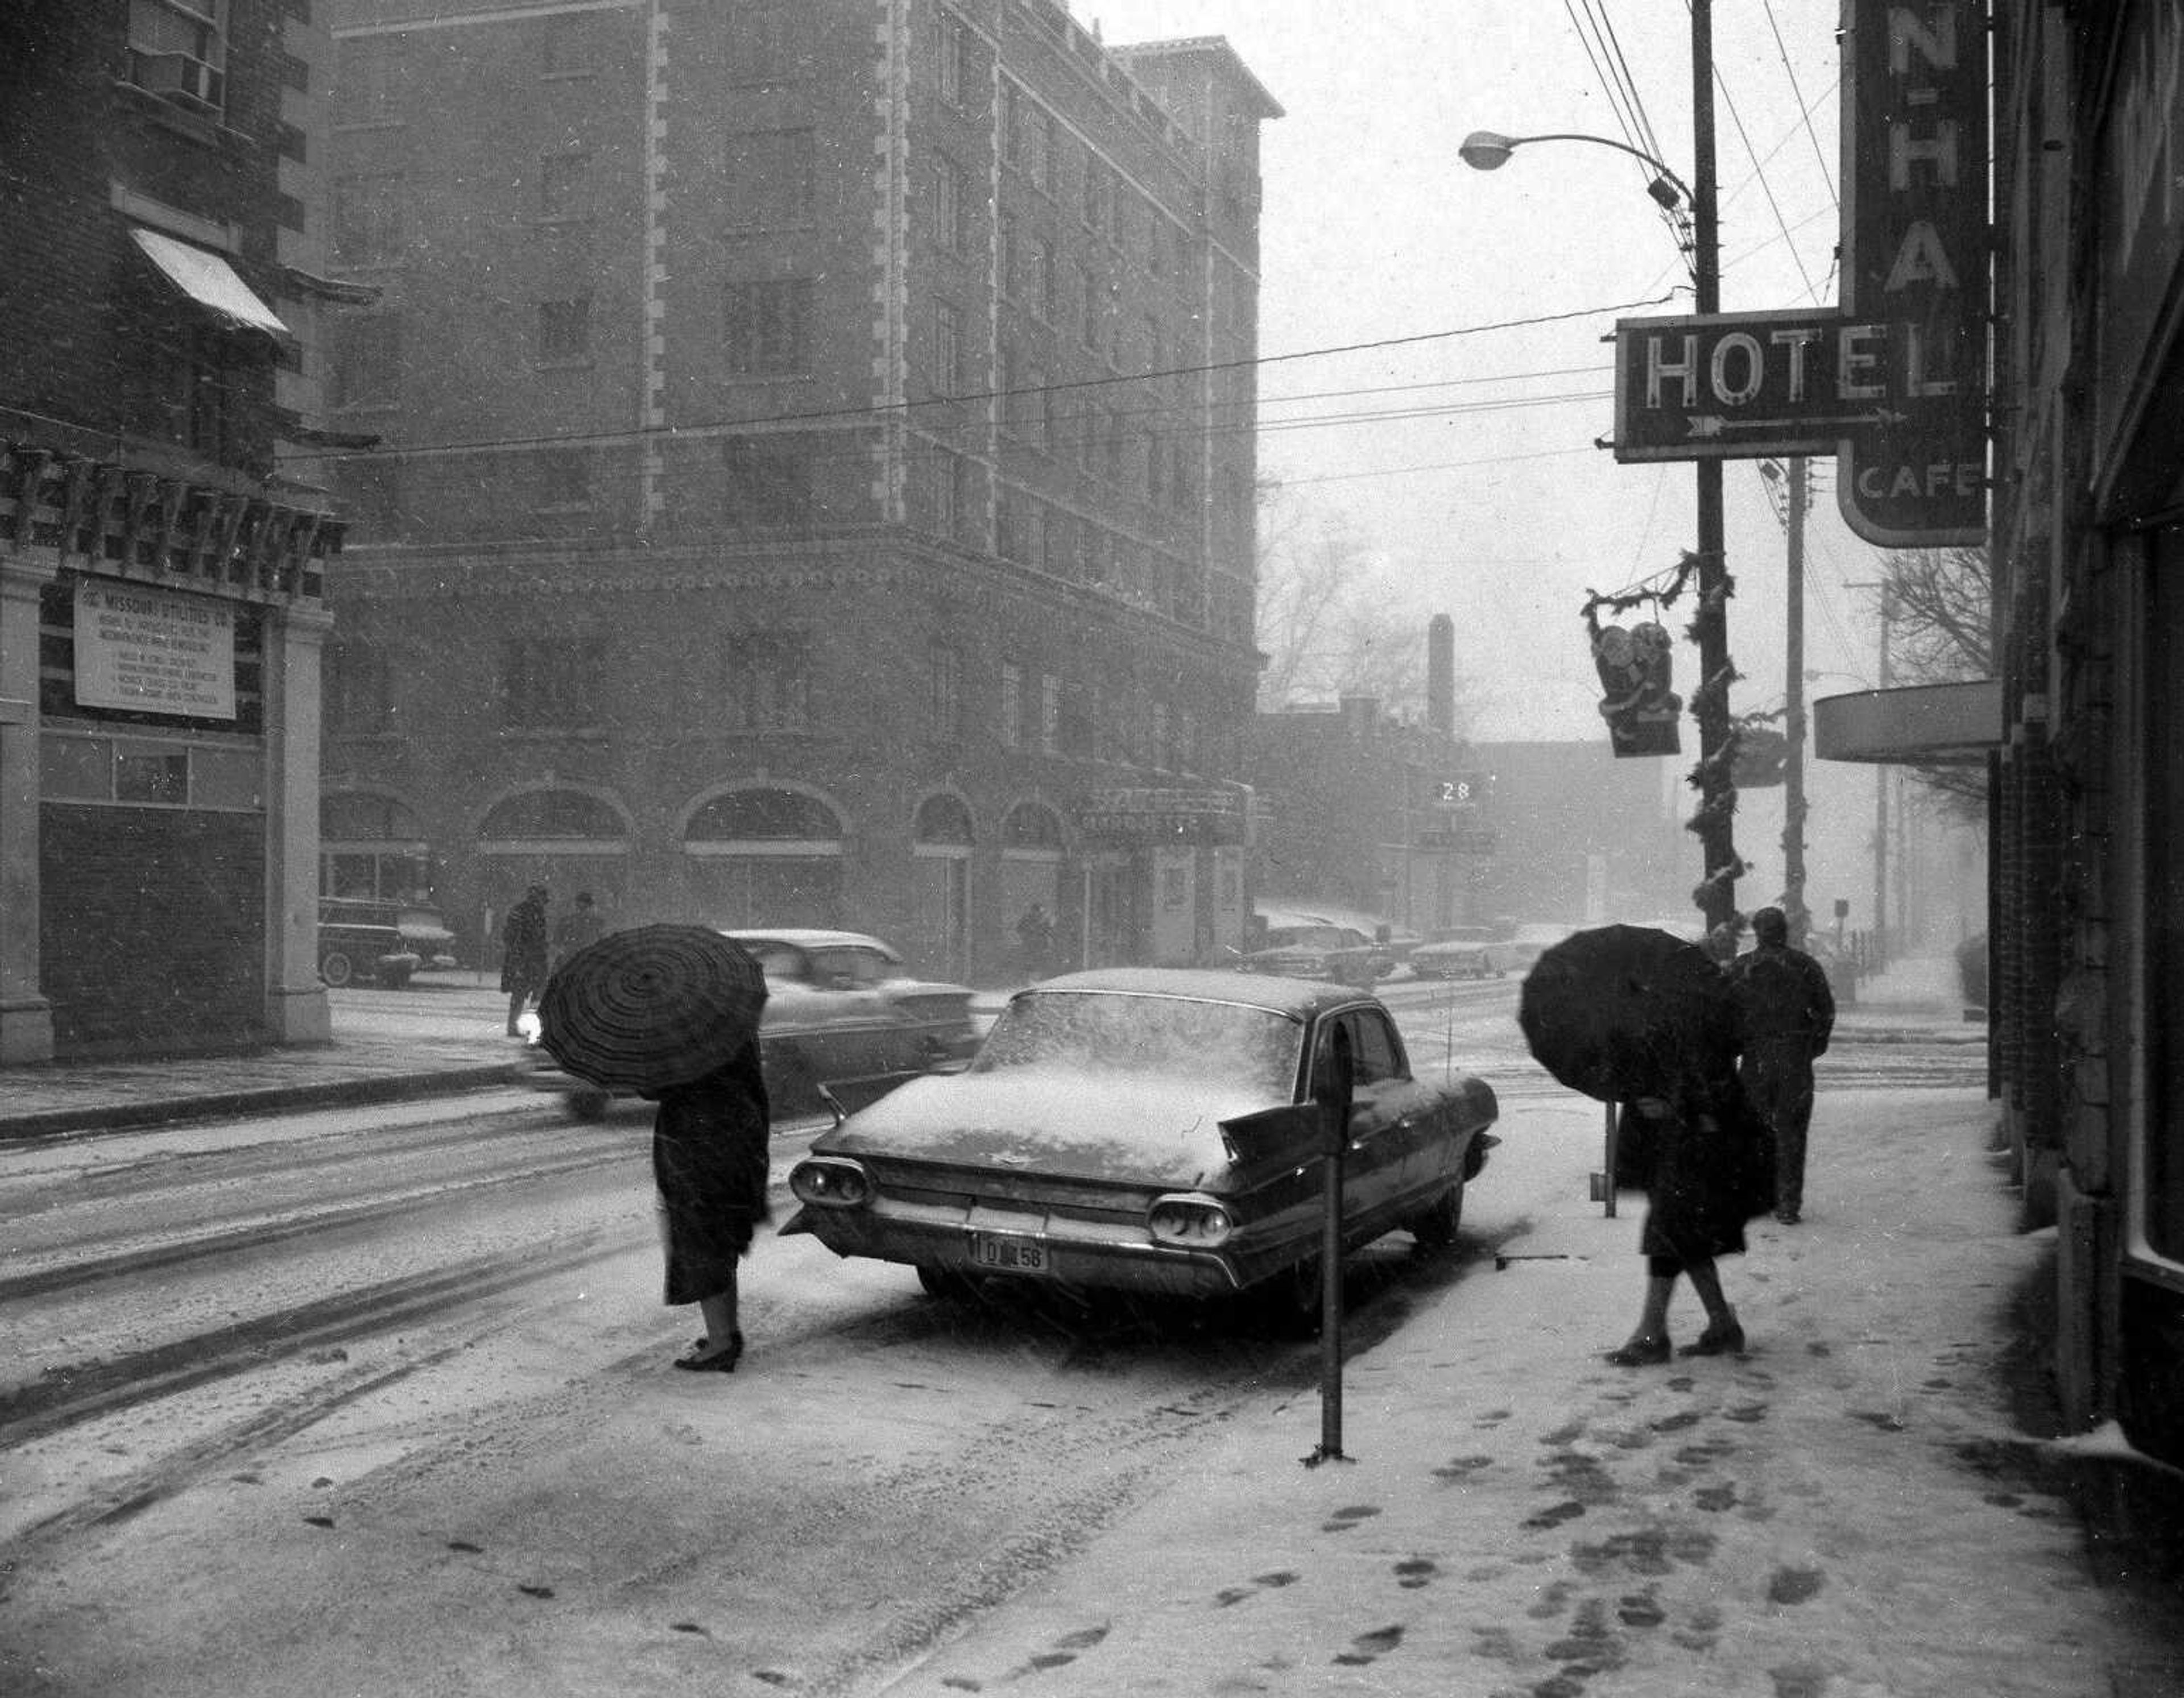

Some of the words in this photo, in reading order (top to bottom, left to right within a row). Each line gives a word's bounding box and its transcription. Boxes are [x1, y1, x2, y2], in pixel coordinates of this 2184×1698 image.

[1647, 321, 1958, 409] HOTEL
[1858, 463, 1983, 499] CAFE
[105, 593, 157, 616] MISSOURI
[1443, 782, 1470, 800] 28
